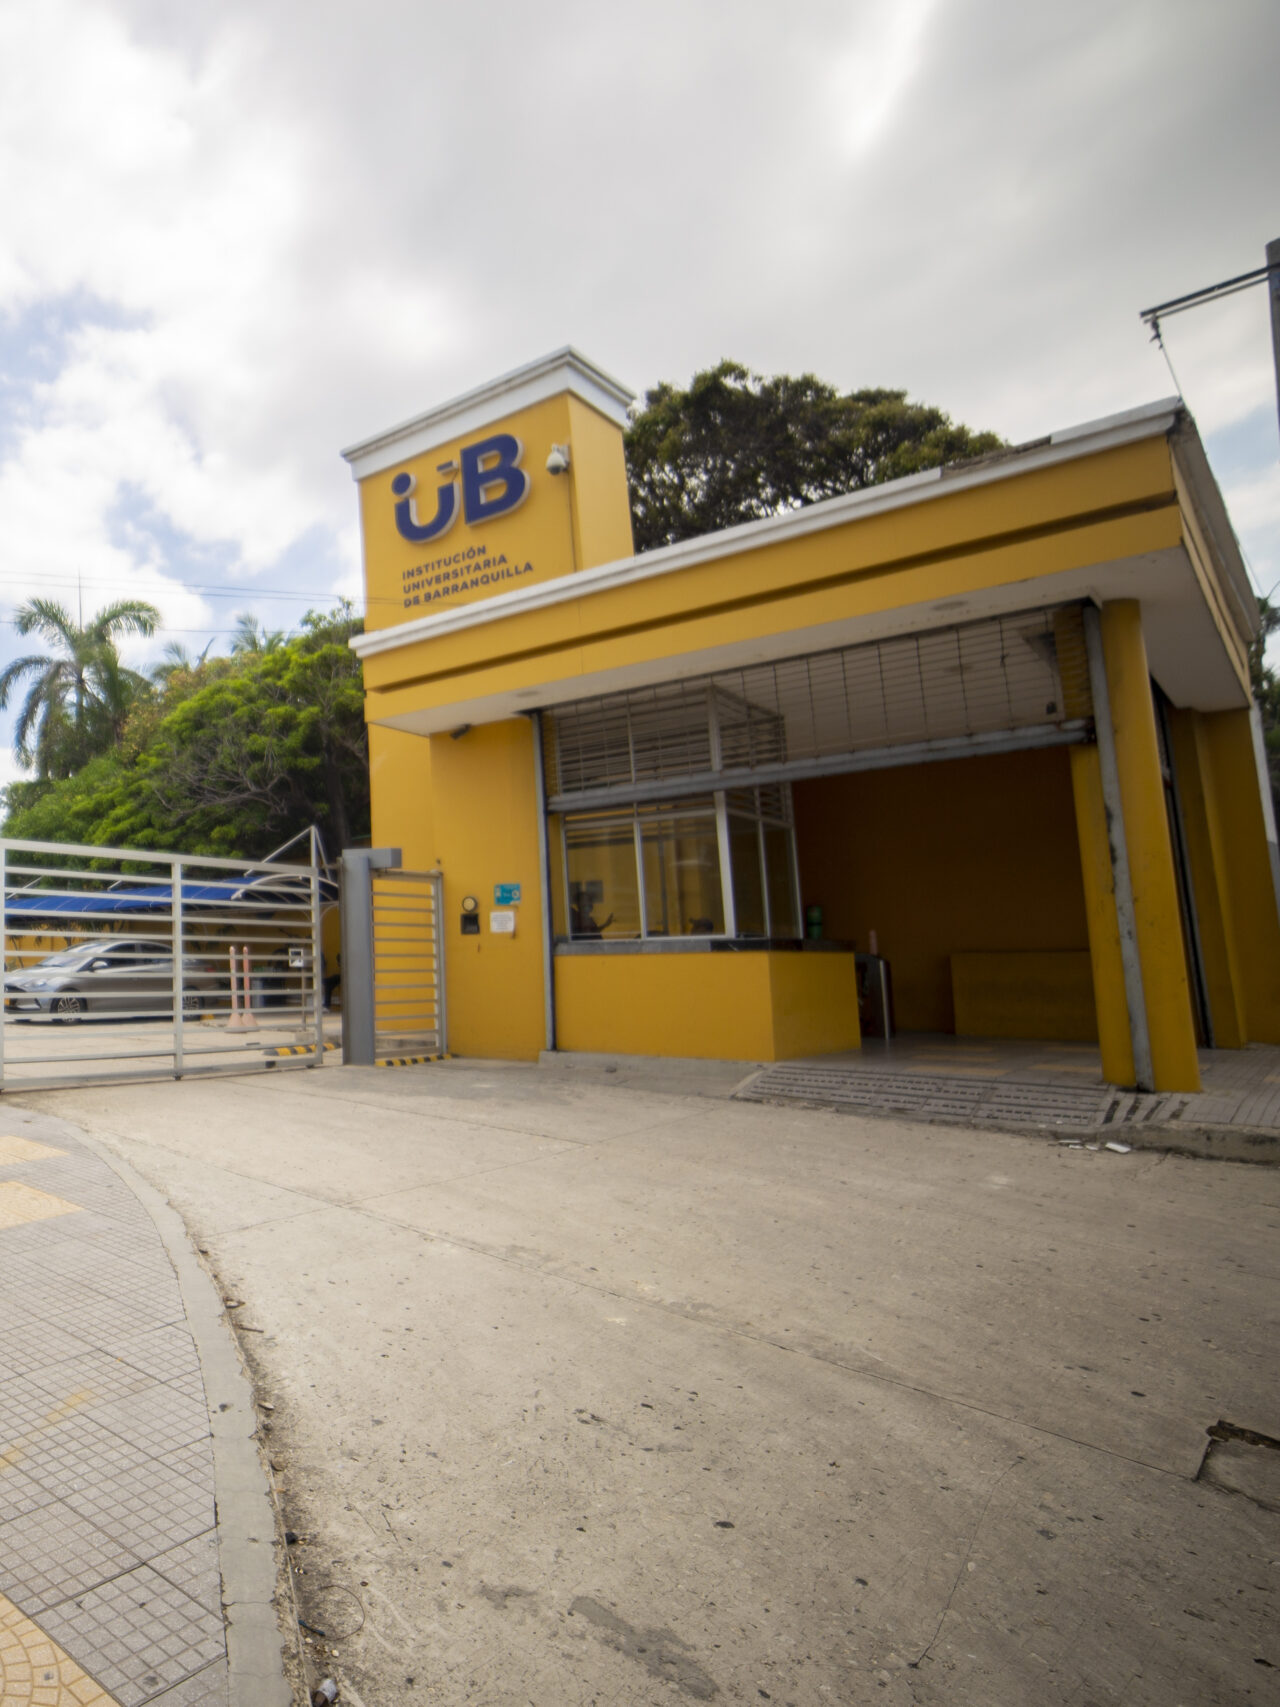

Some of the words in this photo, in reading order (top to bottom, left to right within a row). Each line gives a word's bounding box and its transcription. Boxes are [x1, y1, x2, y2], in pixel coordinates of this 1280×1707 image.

[402, 545, 487, 581] INSTITUCIÓN
[403, 553, 508, 594] UNIVERSITARIA
[403, 594, 420, 609] DE
[424, 562, 533, 602] BARRANQUILLA
